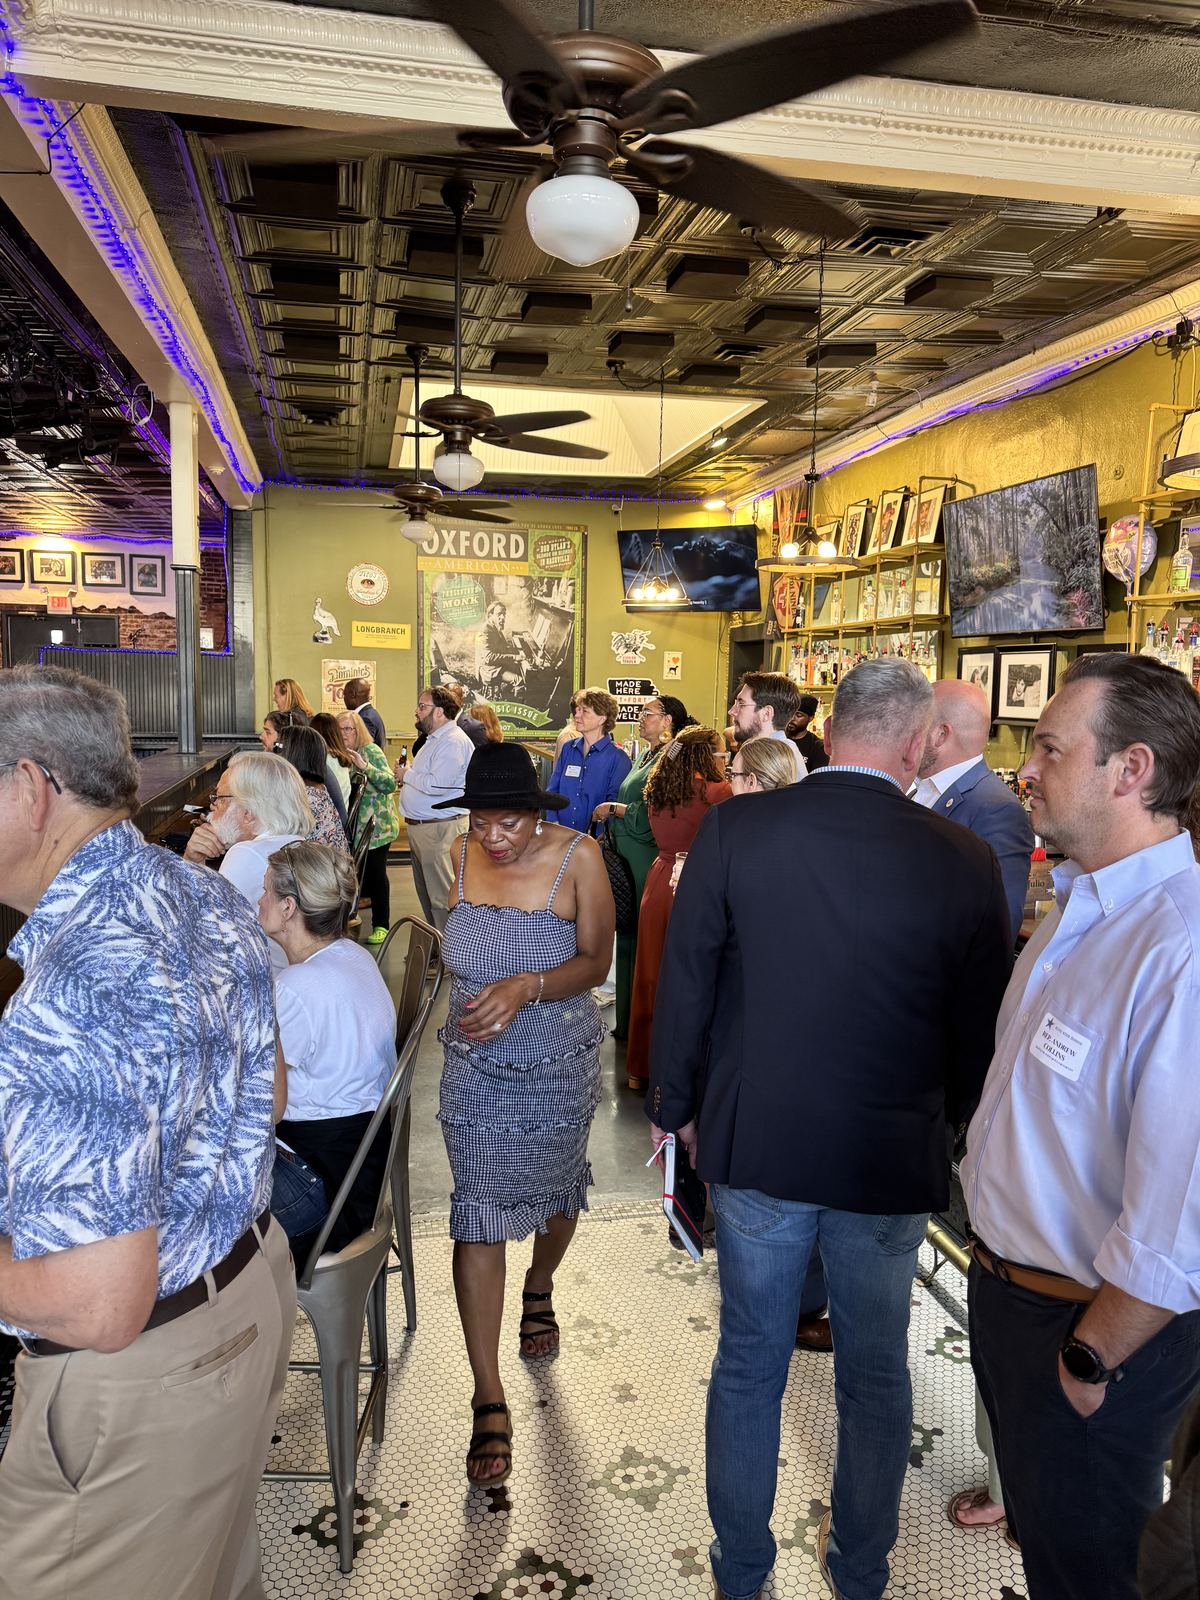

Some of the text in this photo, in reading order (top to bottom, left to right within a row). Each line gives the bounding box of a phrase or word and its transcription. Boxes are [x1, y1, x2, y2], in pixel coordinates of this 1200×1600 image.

[421, 529, 525, 559] OXFORD
[433, 560, 511, 573] AMERICAN
[51, 596, 68, 608] EXIT
[442, 596, 479, 609] MONK
[356, 625, 406, 636] LONGBRANCH
[615, 680, 642, 688] MADE
[616, 687, 641, 695] HERE
[513, 706, 539, 721] ISSUE
[619, 705, 640, 714] ADE
[1043, 1042, 1065, 1061] COLLINS
[1051, 1038, 1077, 1057] ANDREW
